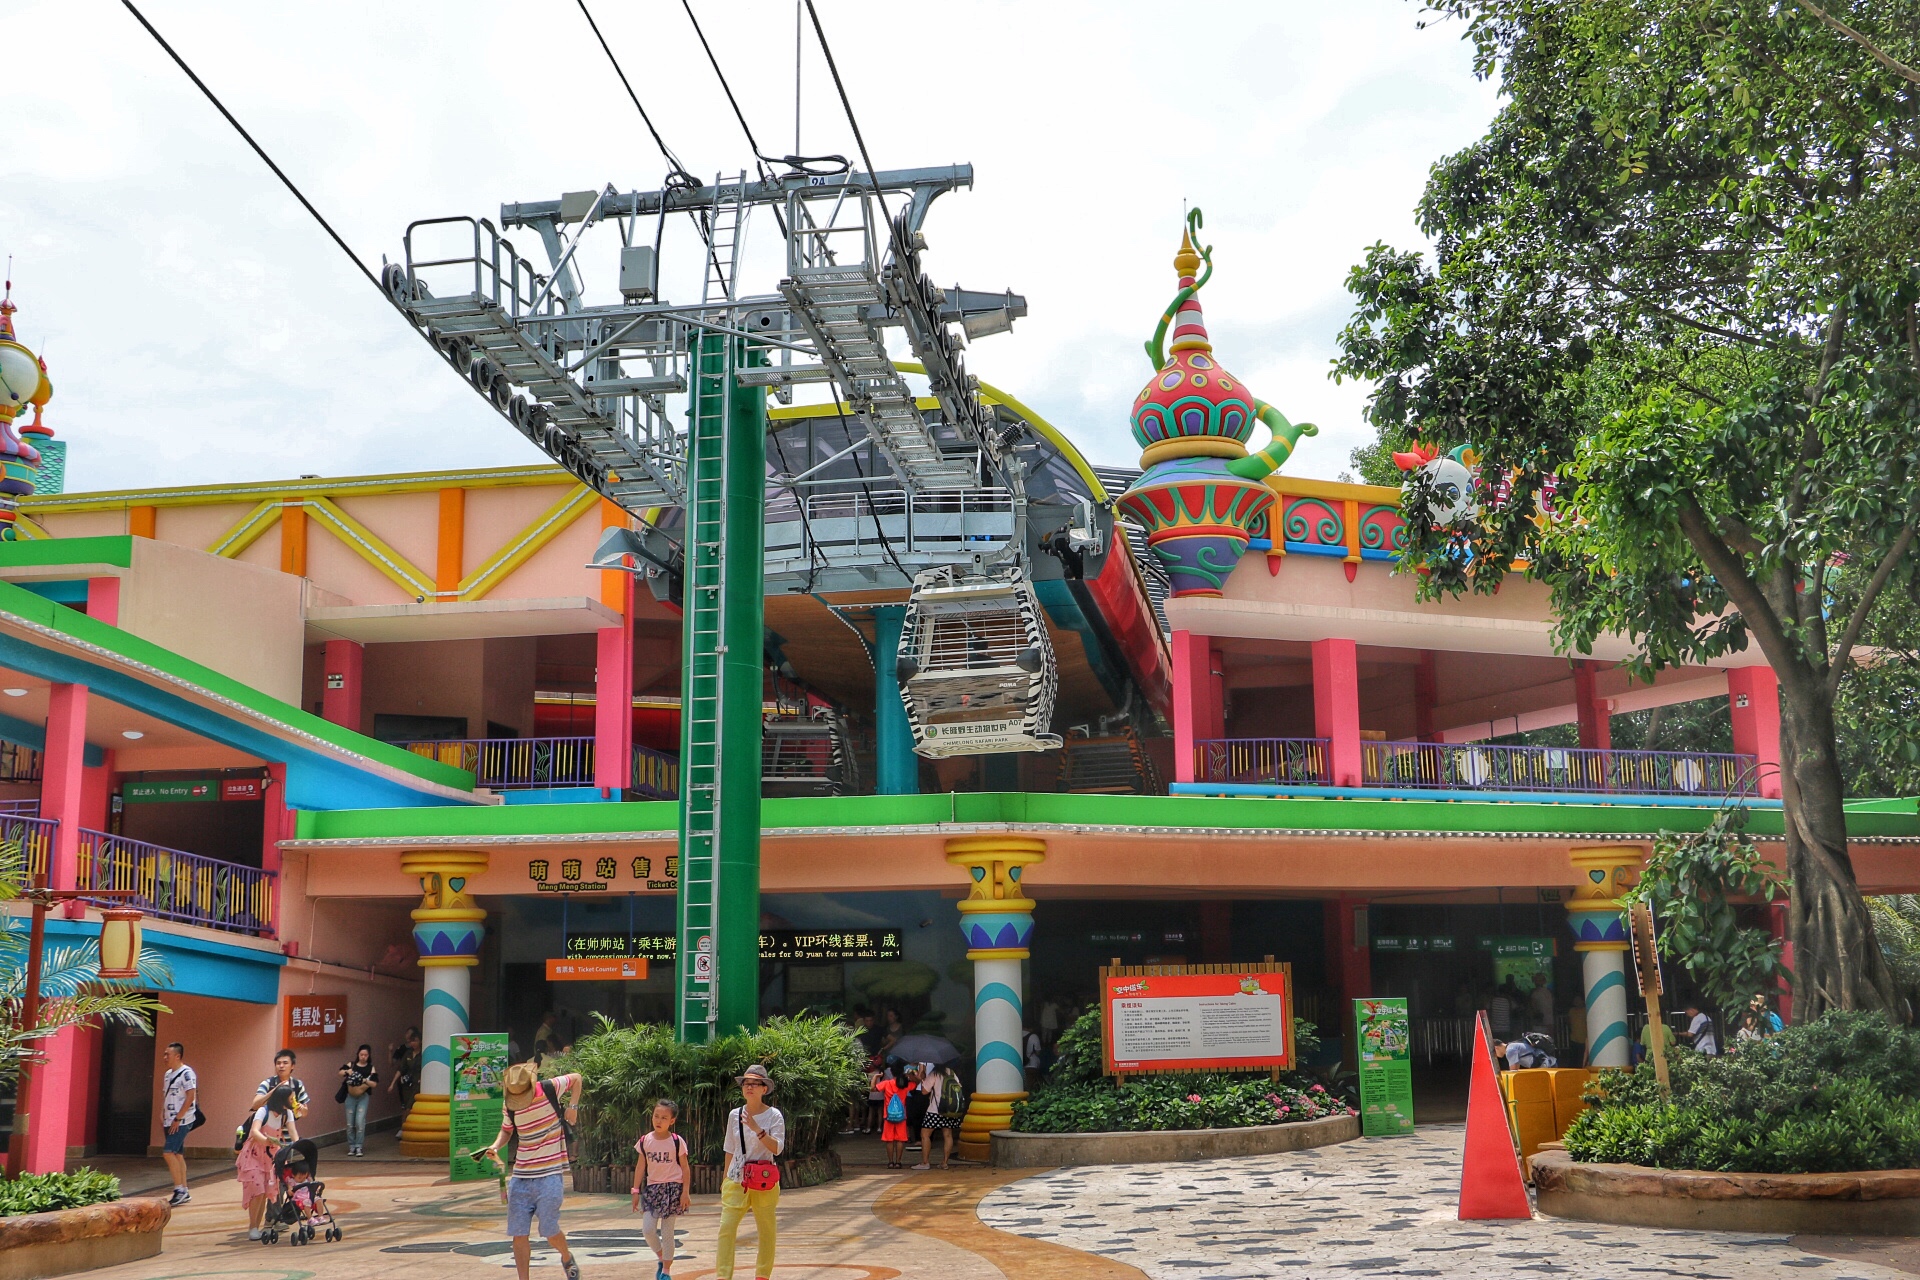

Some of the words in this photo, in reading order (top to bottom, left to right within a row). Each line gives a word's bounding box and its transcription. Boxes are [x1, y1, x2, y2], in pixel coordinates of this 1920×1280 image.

[941, 723, 1008, 736] 长隆野生动物世界
[170, 787, 188, 796] Entry
[538, 883, 558, 891] Meng
[559, 883, 579, 891] Meng
[580, 882, 606, 891] Station
[647, 880, 669, 889] Ticket
[758, 950, 776, 958] ales
[779, 950, 791, 958] for
[806, 951, 823, 959] yuan
[555, 965, 575, 974] 售票处
[577, 965, 595, 973] Ticket
[595, 965, 619, 973] Counter
[291, 1006, 321, 1027] 售票处
[291, 1030, 304, 1038] Ticket
